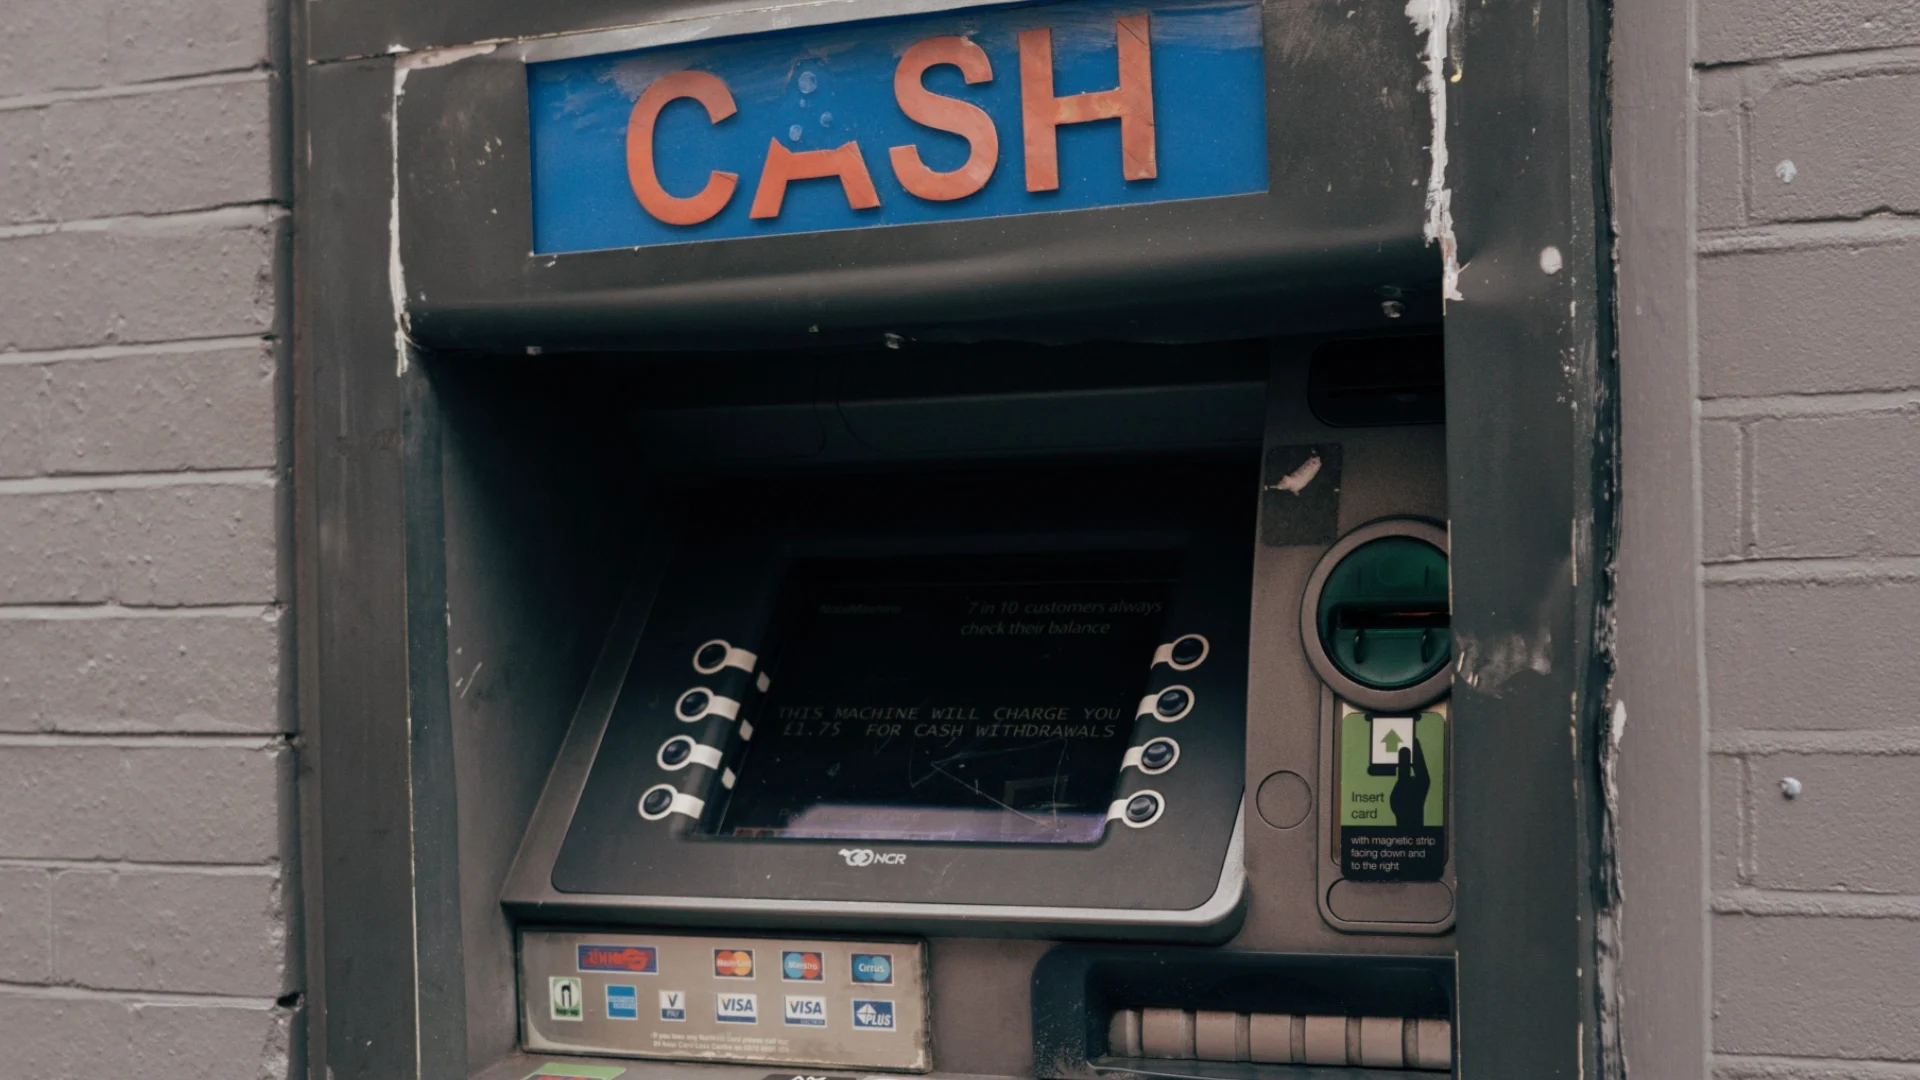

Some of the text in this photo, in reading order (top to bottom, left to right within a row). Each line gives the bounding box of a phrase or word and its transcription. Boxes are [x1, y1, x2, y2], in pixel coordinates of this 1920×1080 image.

[967, 598, 1163, 616] 7 in 10 customers always
[960, 619, 1111, 636] check their balance
[778, 706, 1121, 720] THIS MACHINE WILL CHARGE YOU
[783, 722, 1115, 738] £1.75 FOR CASH WITHDRAWALS
[1351, 791, 1384, 803] Insert
[1351, 808, 1378, 819] card
[1351, 836, 1436, 847] with magnetic strip
[873, 853, 907, 865] NCR
[1351, 848, 1426, 860] facing down and
[1351, 861, 1399, 872] to the right
[858, 963, 884, 973] Cirrus
[667, 993, 678, 1007] V
[722, 998, 754, 1012] VISA
[790, 1001, 822, 1015] VISA
[866, 1013, 891, 1026] PLUS
